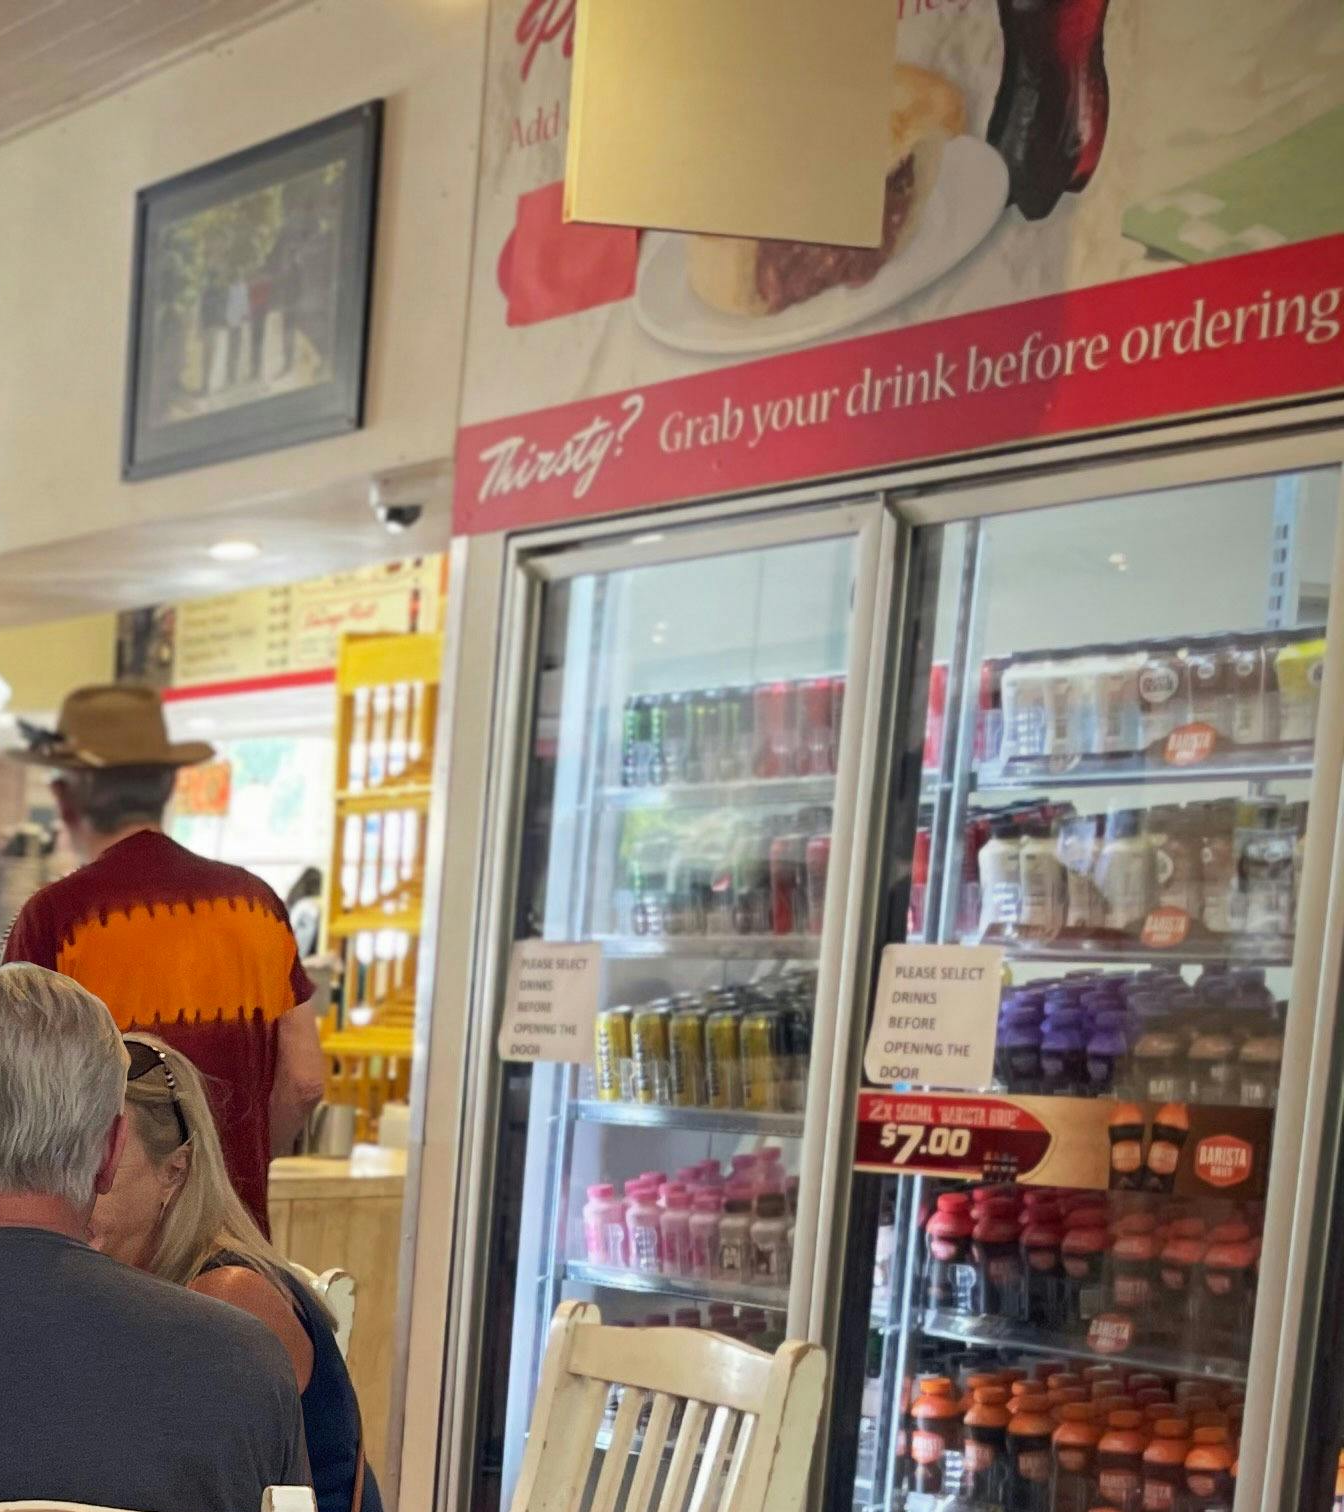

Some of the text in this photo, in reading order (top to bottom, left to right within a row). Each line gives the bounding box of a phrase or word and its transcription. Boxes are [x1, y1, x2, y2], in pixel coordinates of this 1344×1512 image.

[479, 287, 1342, 503] Thirsty? Grab your drink before ordering
[520, 959, 588, 970] PLEASE SELECT
[895, 966, 985, 981] PLEASE SELECT
[891, 991, 937, 1005] DRINKS
[560, 1023, 577, 1035] THE
[888, 1016, 936, 1030] BEFORE
[510, 1044, 541, 1055] DOOR
[883, 1041, 971, 1057] OPENING THE
[879, 1066, 920, 1080] DOOR
[879, 1122, 971, 1164] $7.00
[1199, 1146, 1247, 1167] BARISTA
